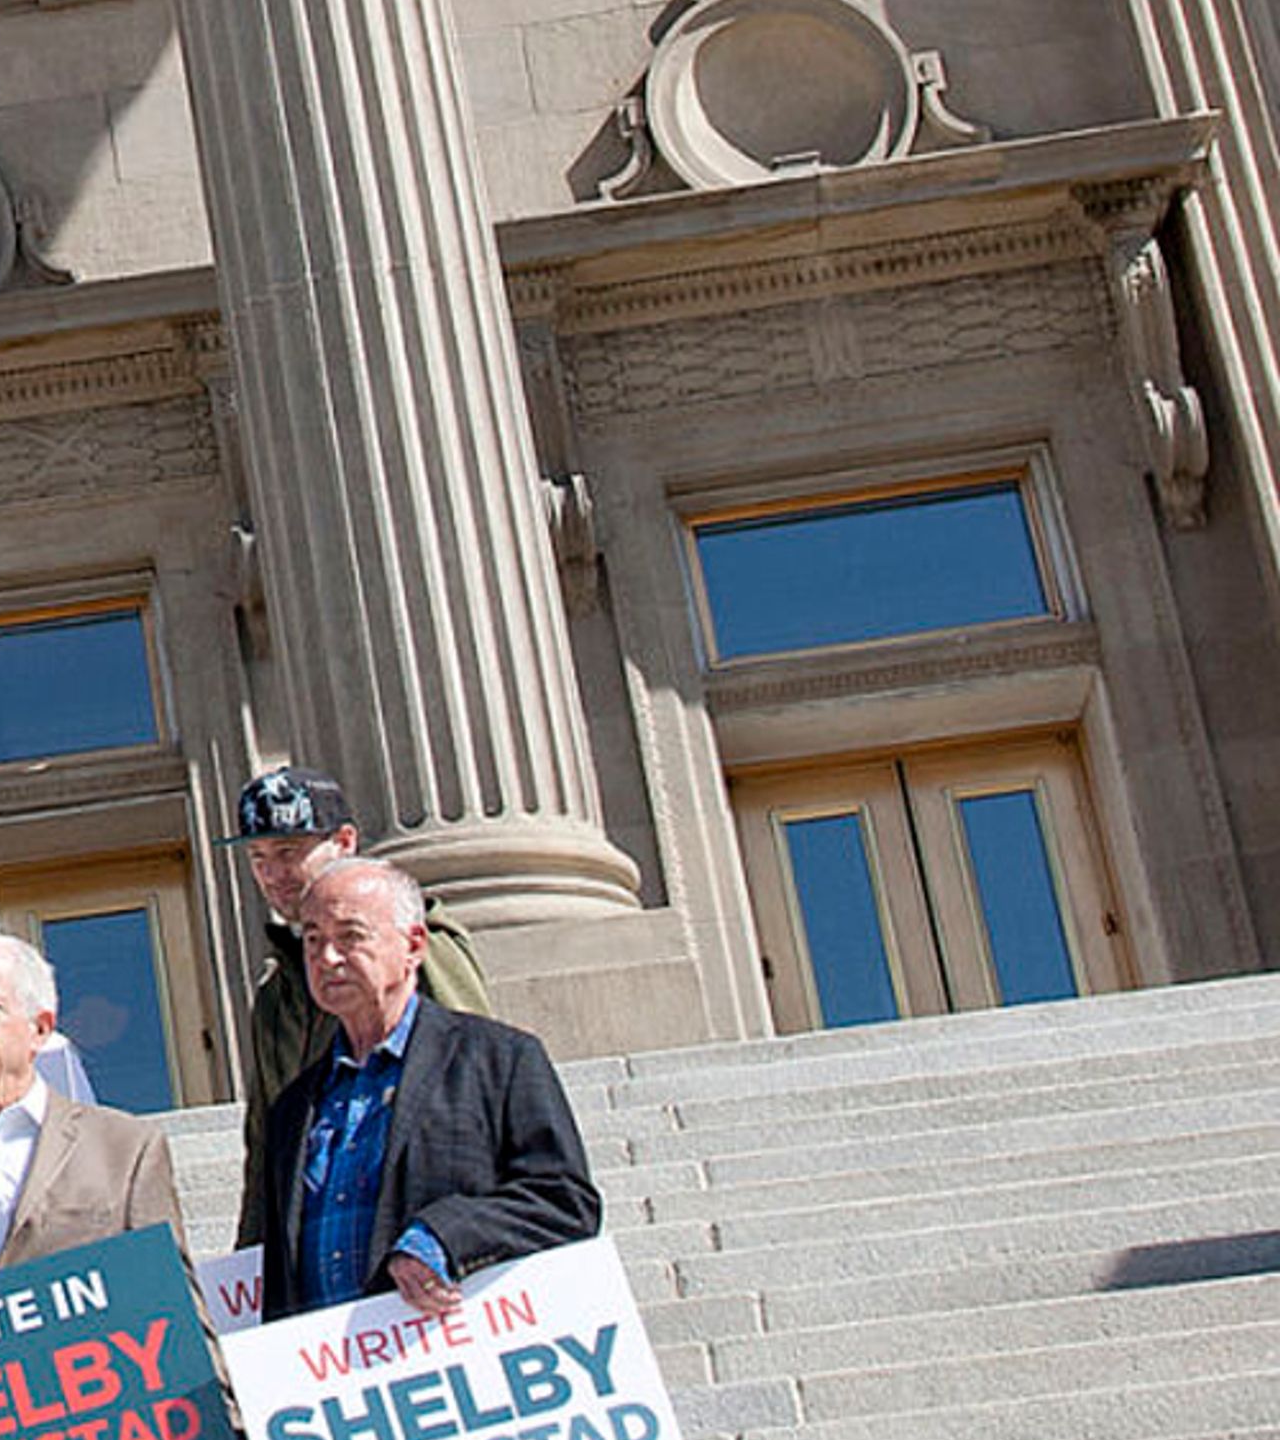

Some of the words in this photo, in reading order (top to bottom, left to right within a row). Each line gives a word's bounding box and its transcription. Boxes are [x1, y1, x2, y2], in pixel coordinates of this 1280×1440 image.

[51, 1271, 109, 1320] IN
[299, 1306, 472, 1382] WRITE
[483, 1290, 538, 1336] IN
